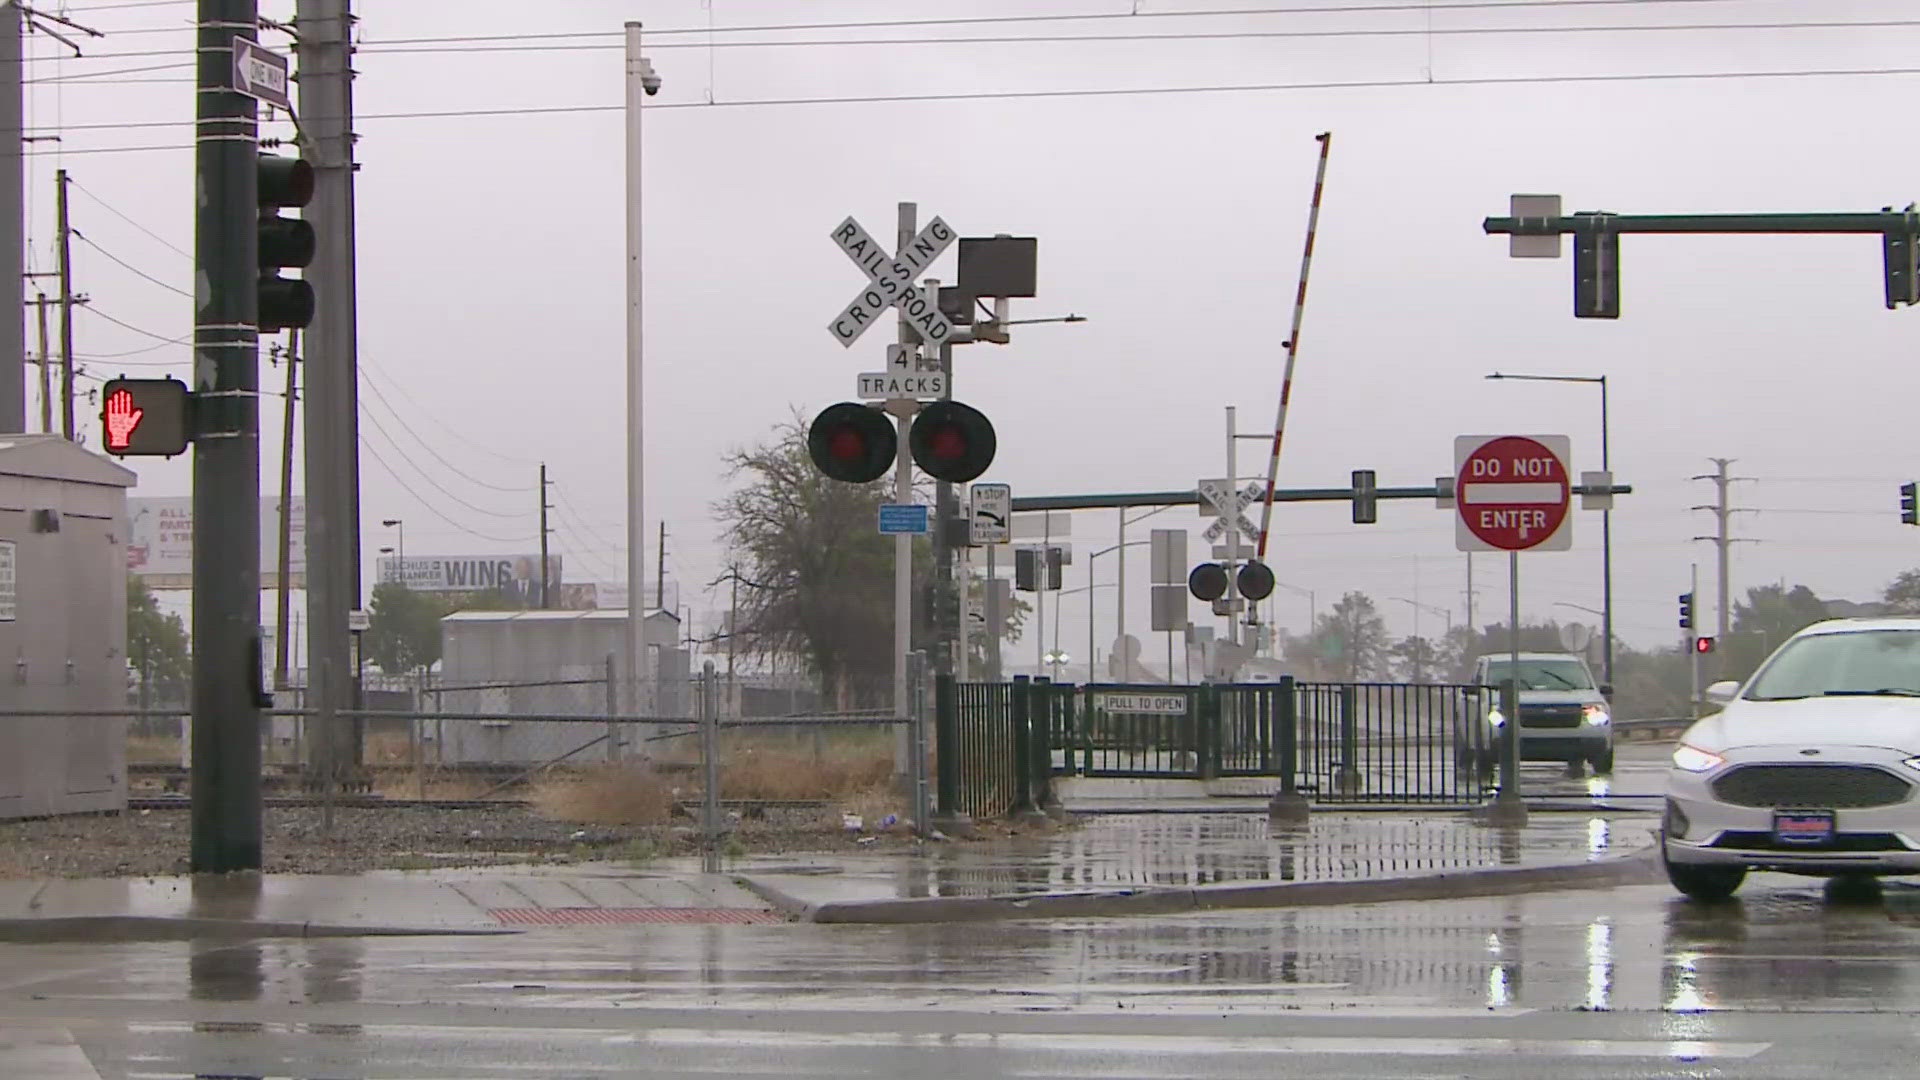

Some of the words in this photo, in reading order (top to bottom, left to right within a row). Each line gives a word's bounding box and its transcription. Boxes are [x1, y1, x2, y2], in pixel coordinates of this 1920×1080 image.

[249, 60, 266, 83] ONE
[266, 65, 284, 89] WAY
[836, 223, 949, 339] CROSSING
[894, 349, 908, 369] 4
[862, 378, 941, 393] TRACKS
[1473, 458, 1500, 477] DO
[1513, 458, 1553, 477] NOT
[984, 489, 1006, 500] STOP
[1480, 510, 1546, 529] ENTER
[444, 560, 512, 586] WINS
[1109, 697, 1133, 709] PULL
[1139, 698, 1151, 709] TO
[1154, 698, 1182, 710] OPEN
